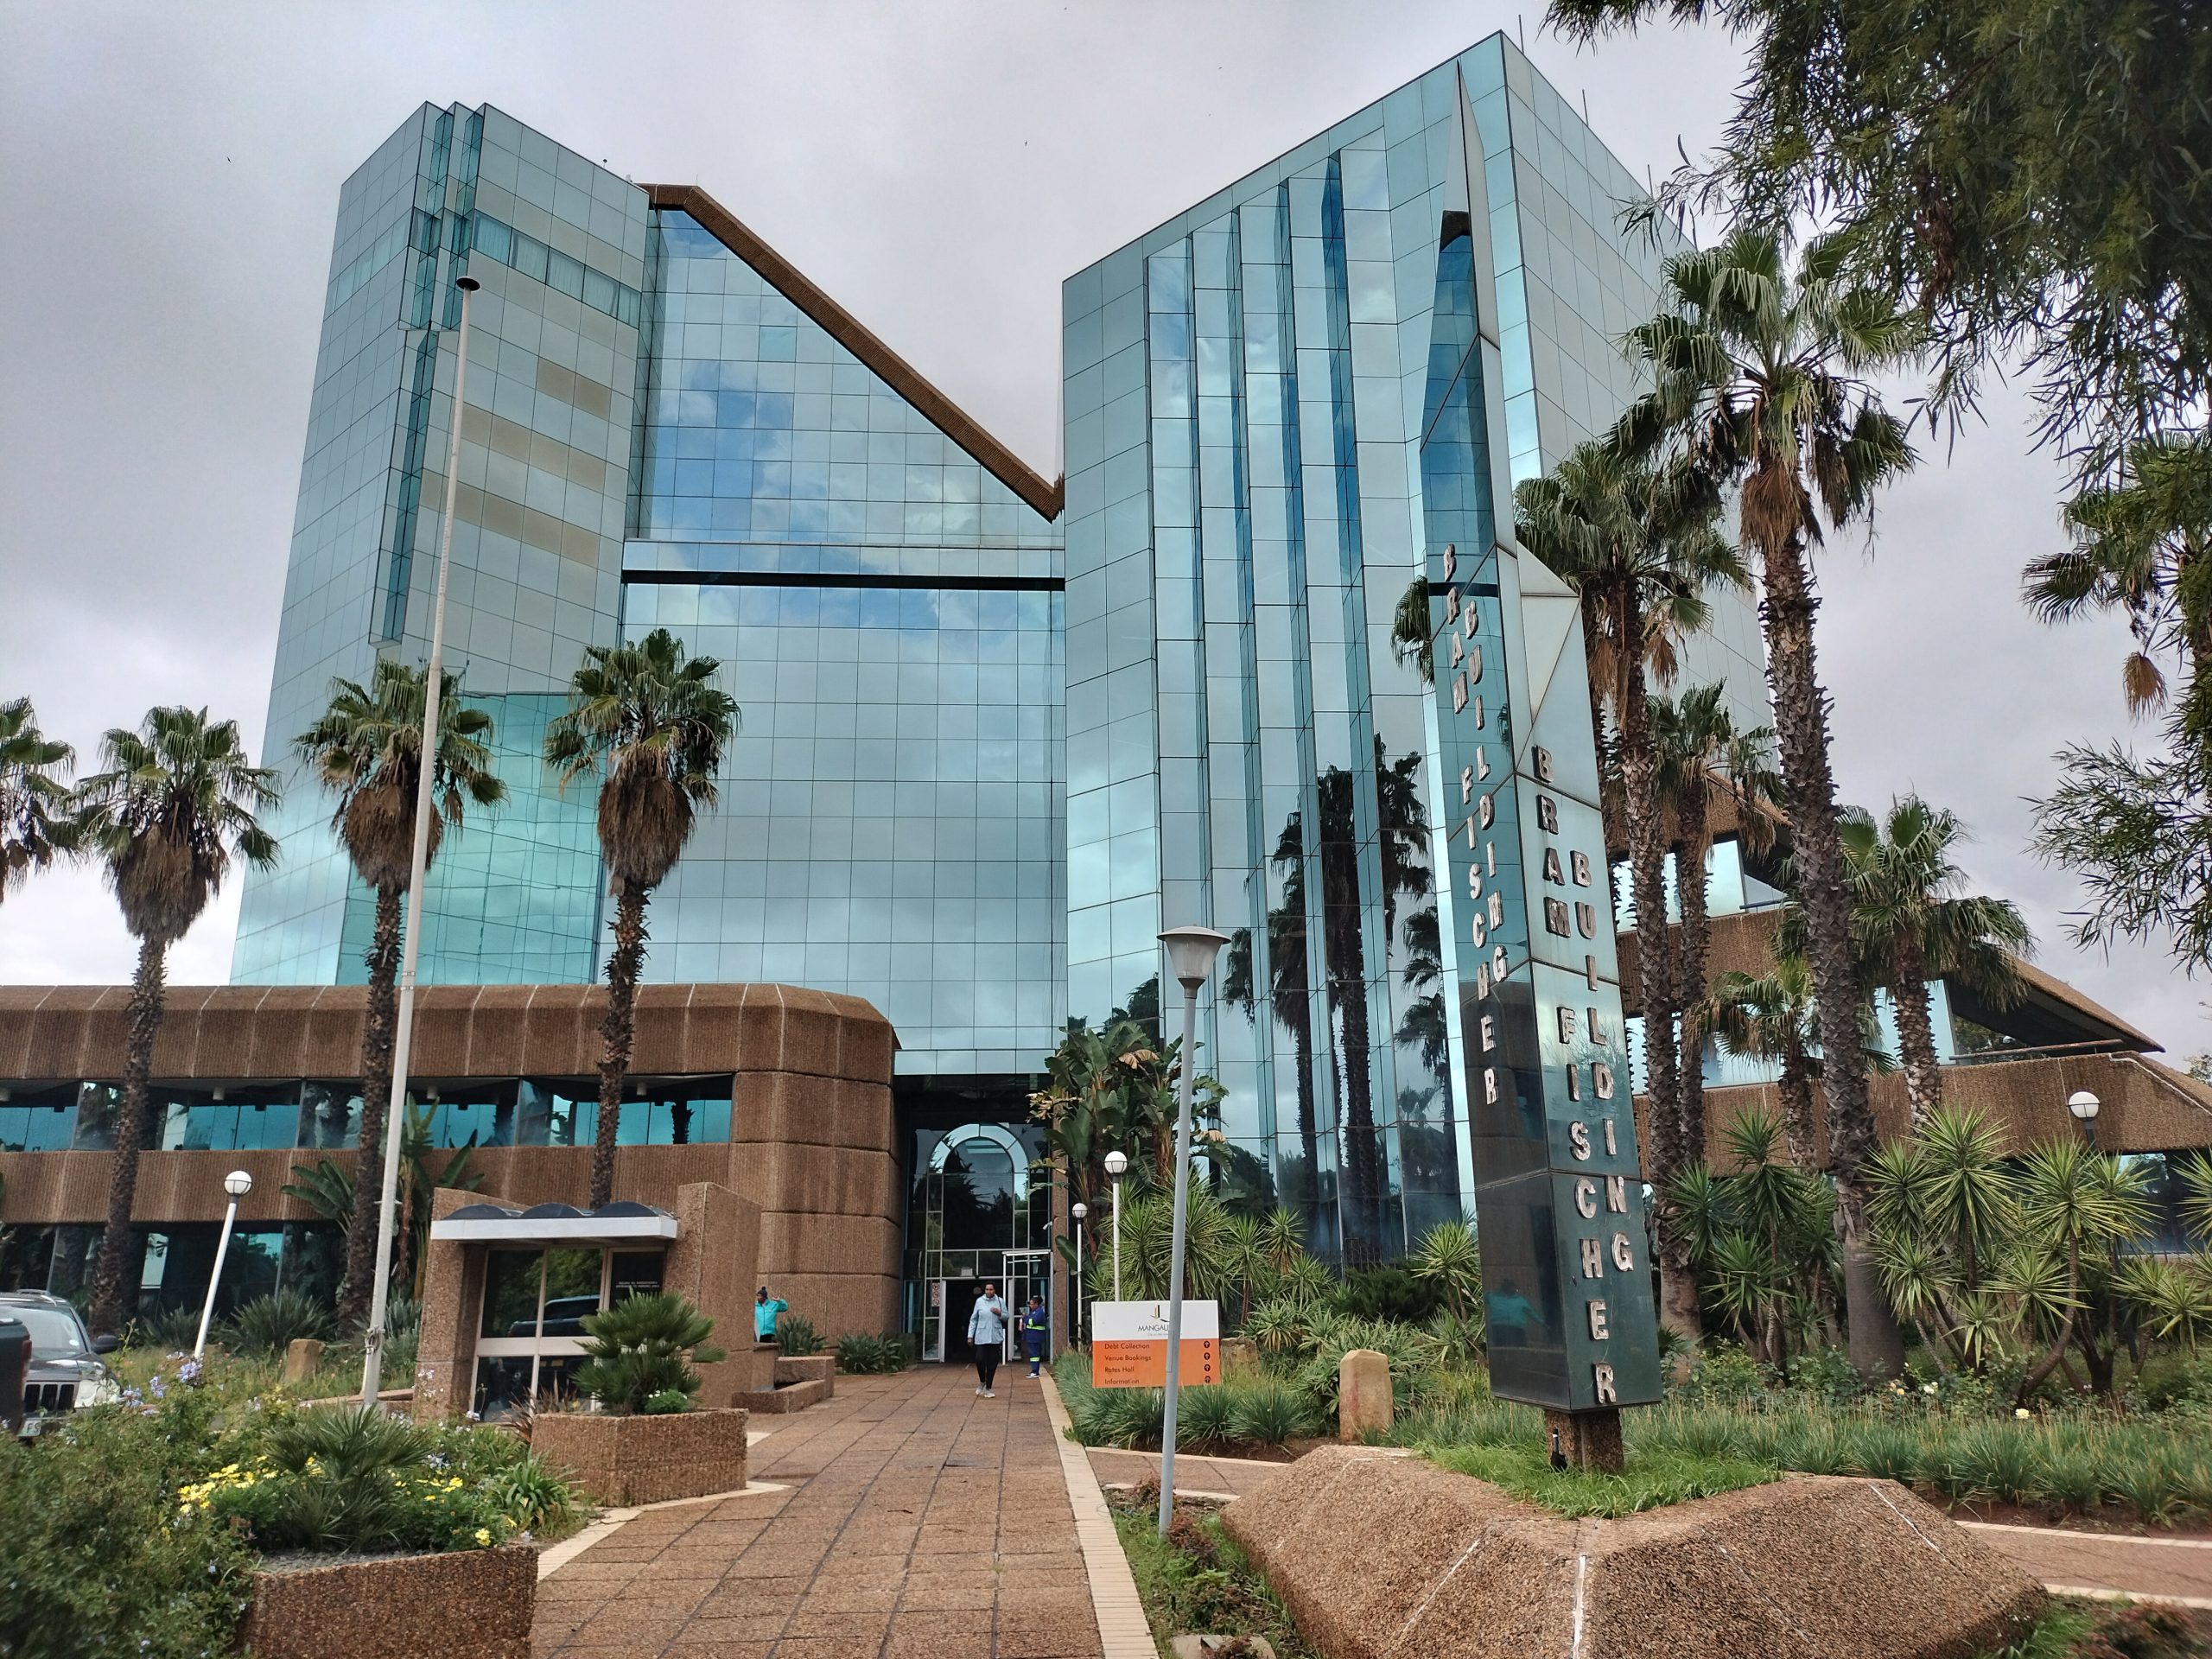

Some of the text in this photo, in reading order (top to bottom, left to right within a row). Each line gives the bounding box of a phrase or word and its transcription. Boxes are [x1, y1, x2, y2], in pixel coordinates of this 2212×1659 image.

[1444, 543, 1499, 1105] BRAM FISCHER
[1465, 601, 1509, 982] BUILDING
[1532, 745, 1617, 1404] BRAM FISCHER
[1570, 849, 1634, 1272] BUILDING
